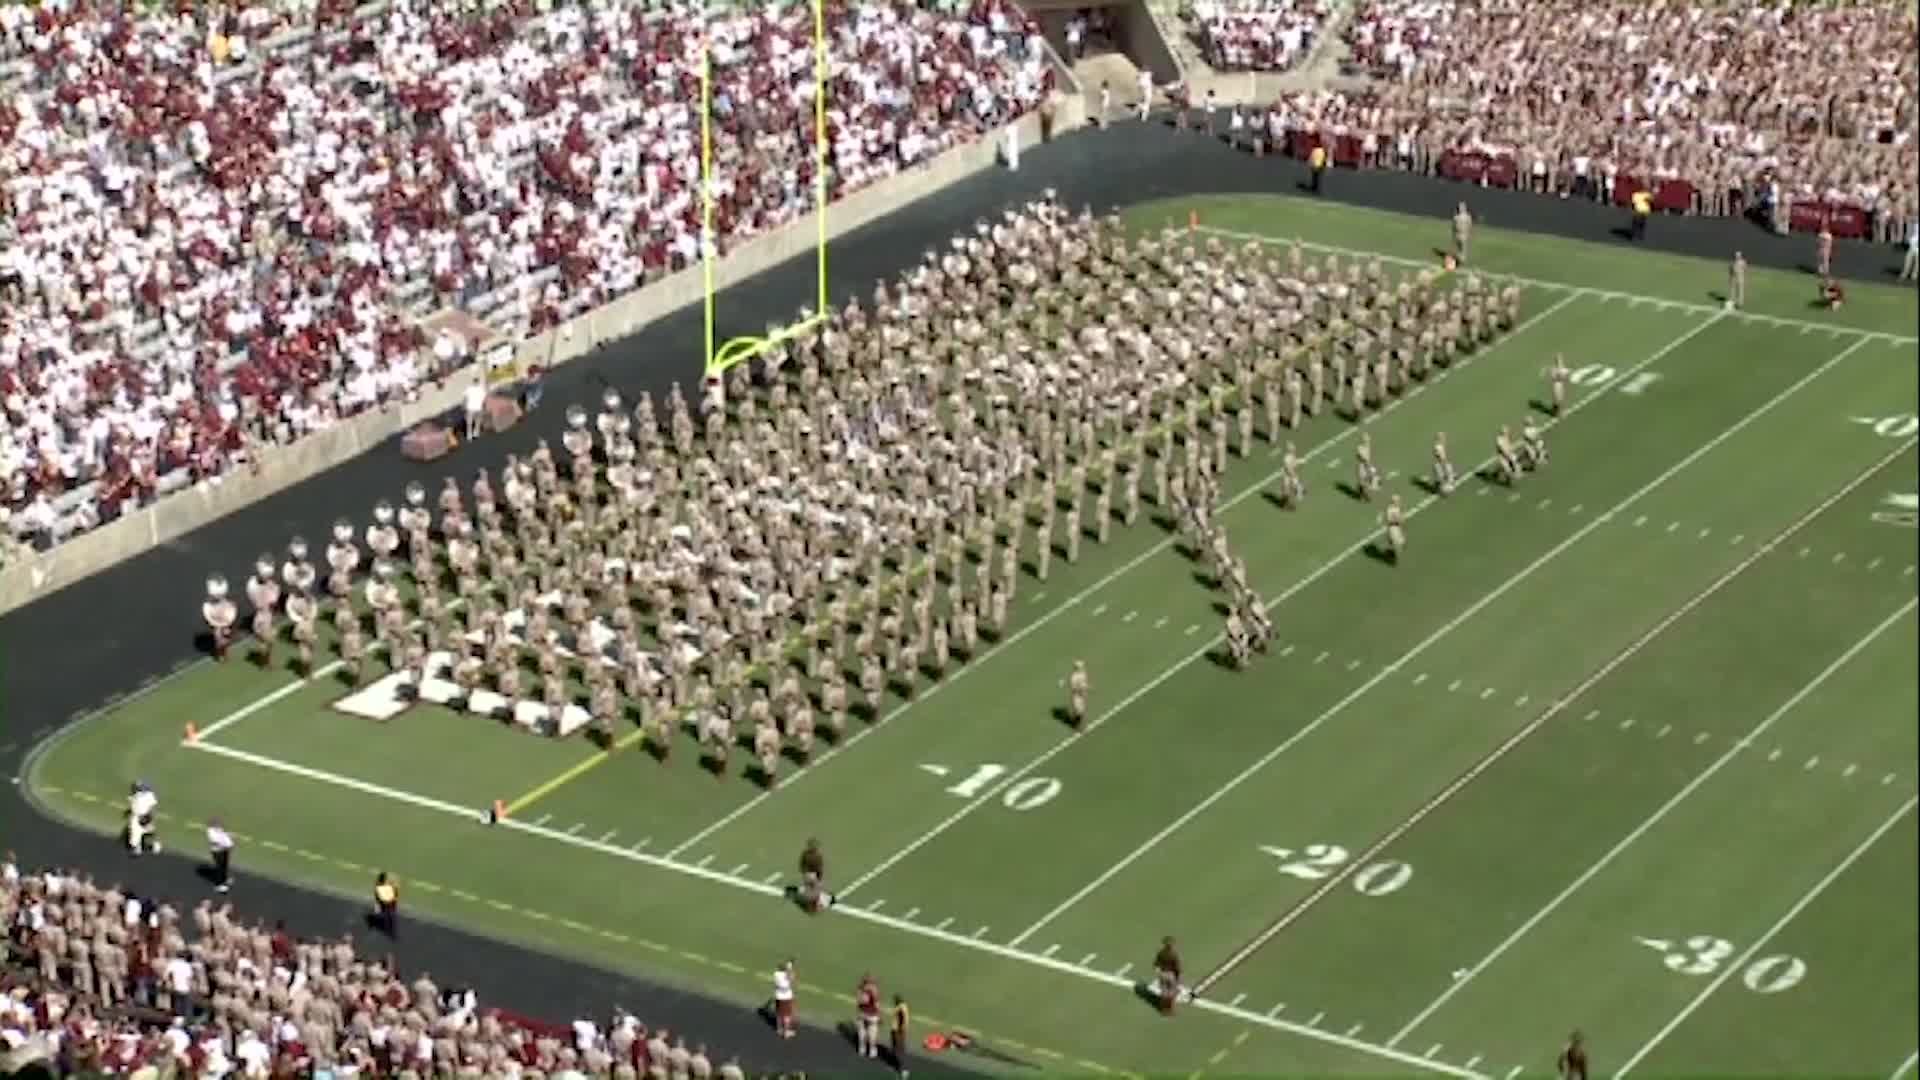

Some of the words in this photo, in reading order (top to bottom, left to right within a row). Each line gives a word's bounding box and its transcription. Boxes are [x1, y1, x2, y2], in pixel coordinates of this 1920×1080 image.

[945, 764, 1062, 811] 10
[1278, 844, 1413, 896] 20
[1663, 935, 1807, 993] 30
